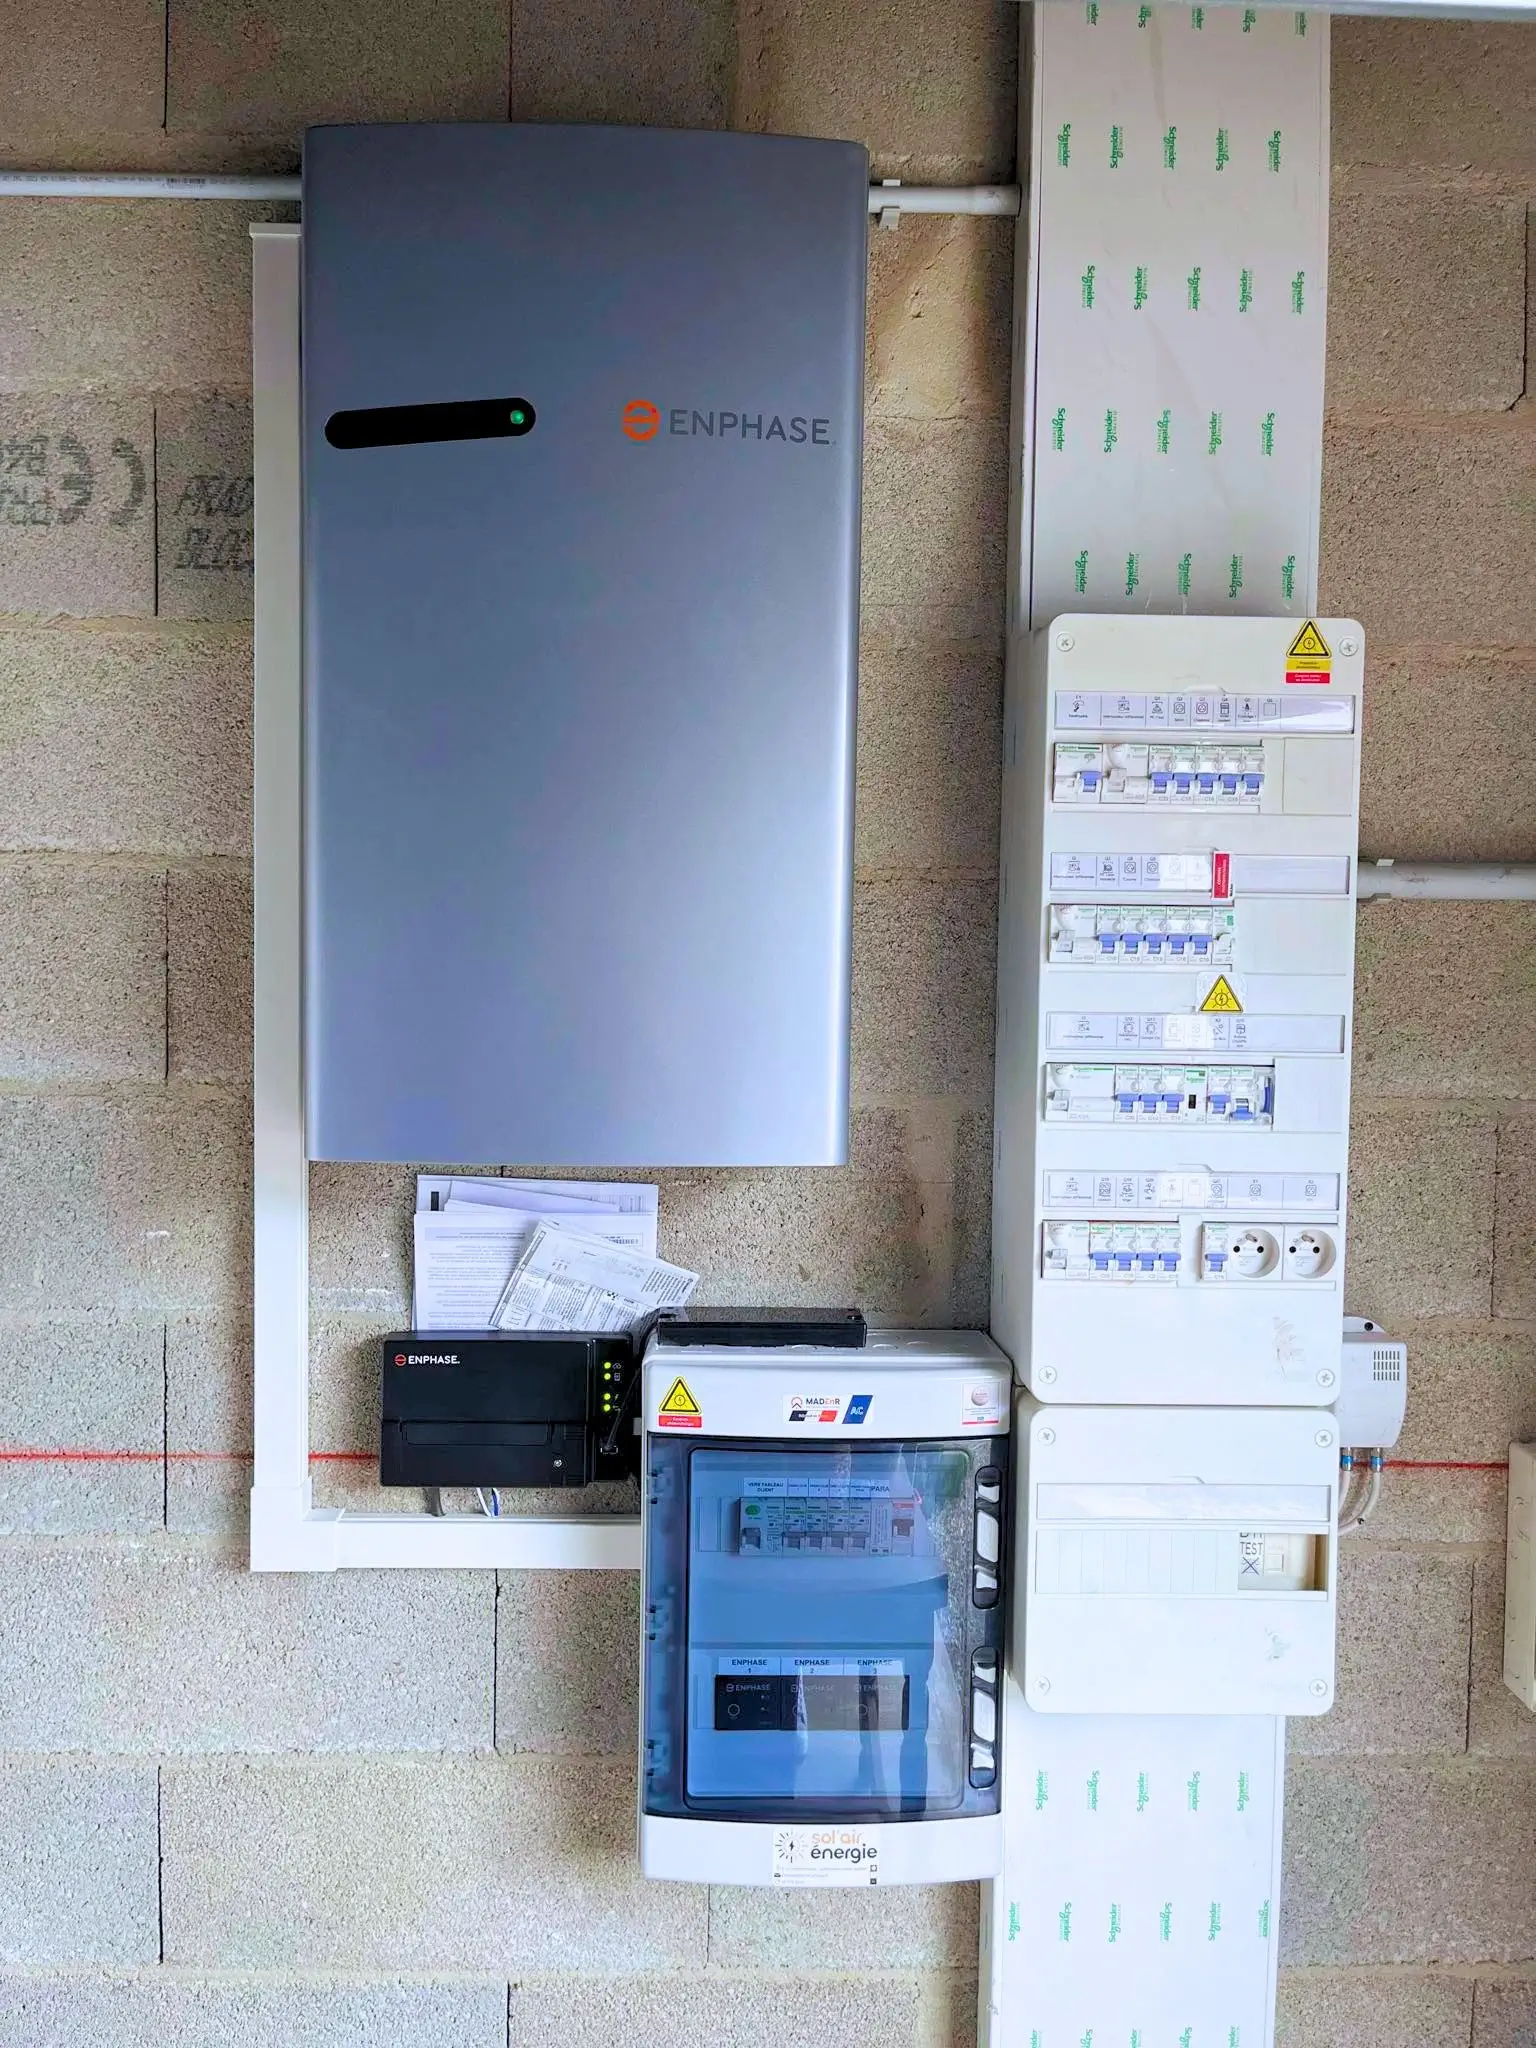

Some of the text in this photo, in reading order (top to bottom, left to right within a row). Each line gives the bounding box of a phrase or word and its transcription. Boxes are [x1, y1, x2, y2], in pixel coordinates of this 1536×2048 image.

[1058, 123, 1071, 168] Schneider
[1110, 125, 1123, 168] Schneider
[1163, 126, 1177, 170] Schneider
[1216, 128, 1229, 171] Schneider
[1268, 130, 1281, 173] Schneider
[1081, 265, 1095, 309] Schneider
[1134, 266, 1148, 310] Schneider
[1187, 267, 1201, 312] Schneider
[1239, 269, 1252, 313] Schneider
[1291, 271, 1305, 315] Schneider
[1051, 407, 1066, 452] Schneider
[1104, 409, 1117, 453] Schneider
[1156, 409, 1171, 454] Schneider
[1208, 411, 1222, 455] Schneider
[1261, 412, 1275, 457] Schneider
[1074, 550, 1088, 594] Schneider
[1125, 552, 1139, 596] Schneider
[1177, 553, 1192, 598] Schneider
[1228, 554, 1242, 598] Schneider
[1281, 555, 1296, 600] Schneider
[850, 1406, 864, 1415] AC
[1239, 1541, 1263, 1555] TEST
[1036, 1770, 1048, 1811] Schneider
[1087, 1770, 1100, 1811] Schneider
[1137, 1772, 1149, 1812] Schneider
[1237, 1771, 1250, 1811] Schneider
[810, 1843, 877, 1864] énergie
[1008, 1902, 1021, 1941] Schneider
[1108, 1903, 1121, 1943] Schneider
[1208, 1901, 1221, 1941] Schneider
